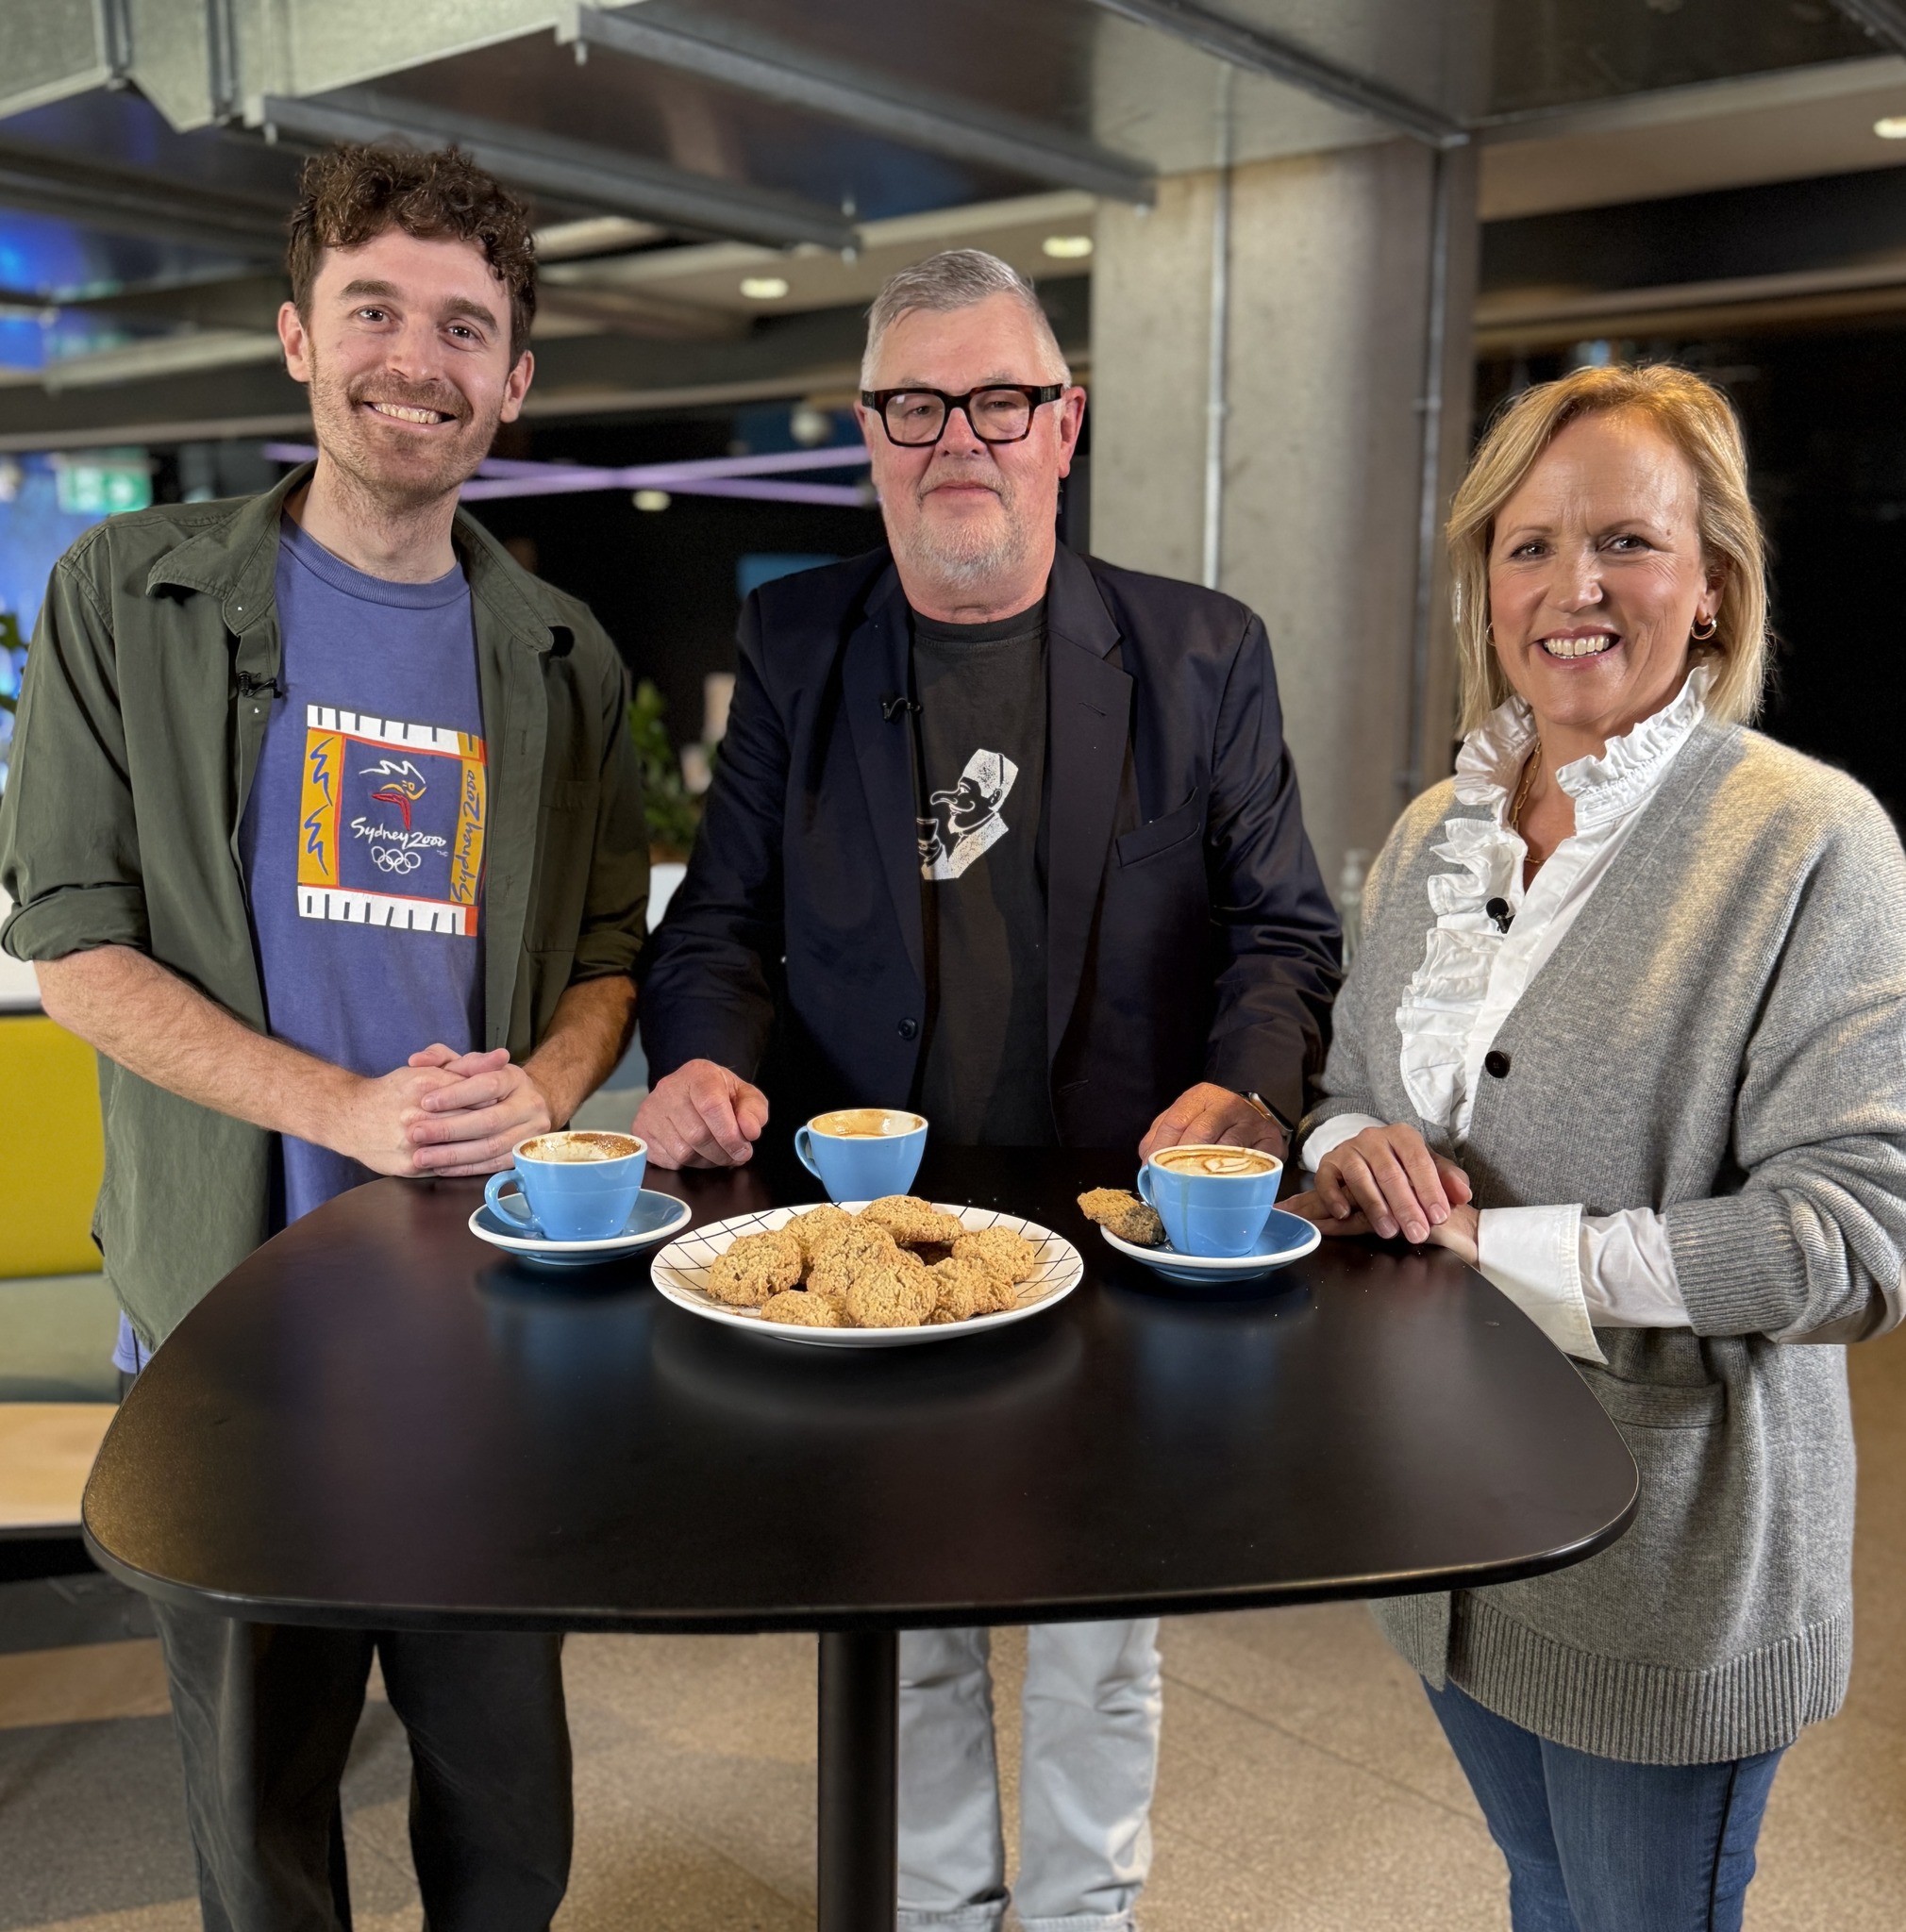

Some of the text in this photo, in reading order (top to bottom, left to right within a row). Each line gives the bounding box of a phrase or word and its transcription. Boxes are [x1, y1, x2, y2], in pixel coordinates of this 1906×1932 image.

[351, 817, 447, 850] Sydney 2000
[451, 769, 483, 902] Sydney 2000
